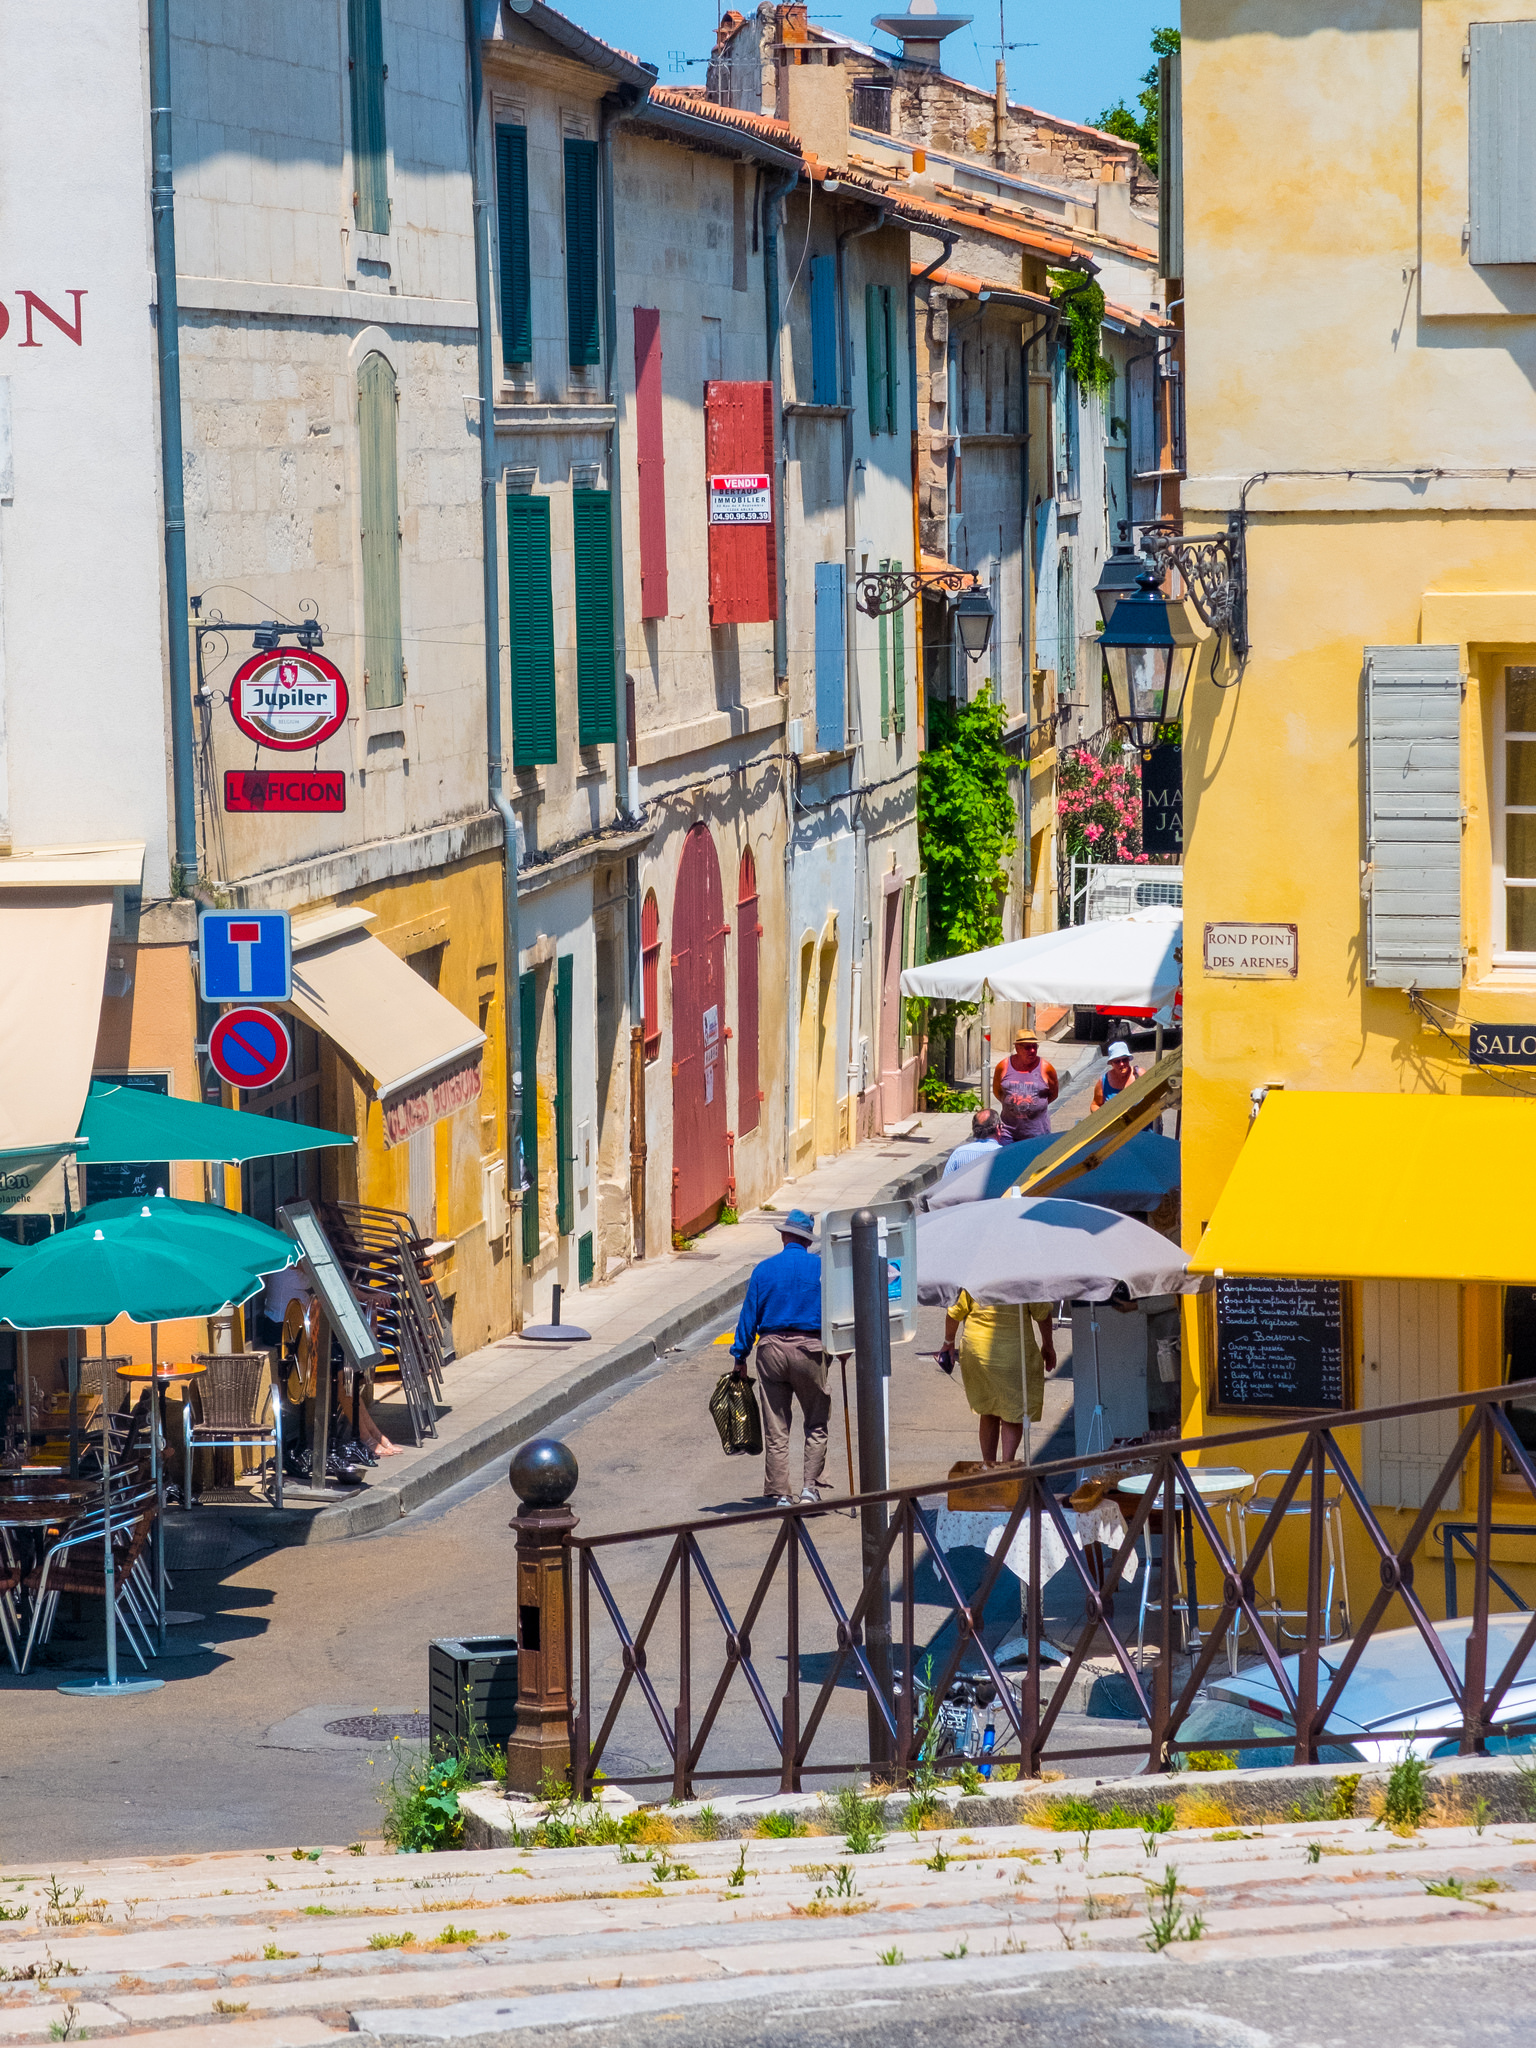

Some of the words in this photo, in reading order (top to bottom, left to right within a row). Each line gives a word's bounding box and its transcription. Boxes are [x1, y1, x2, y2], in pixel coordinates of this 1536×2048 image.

[0, 289, 89, 347] N
[724, 479, 758, 488] VENDU
[713, 512, 768, 520] 04.90.96.59.39
[252, 689, 328, 710] Jupiler
[1209, 934, 1247, 944] ROND
[1251, 934, 1293, 945] POINT
[1213, 957, 1234, 967] DES
[1240, 957, 1289, 968] ARENES
[1476, 1035, 1536, 1055] SALO
[1252, 1330, 1296, 1341] Boissons
